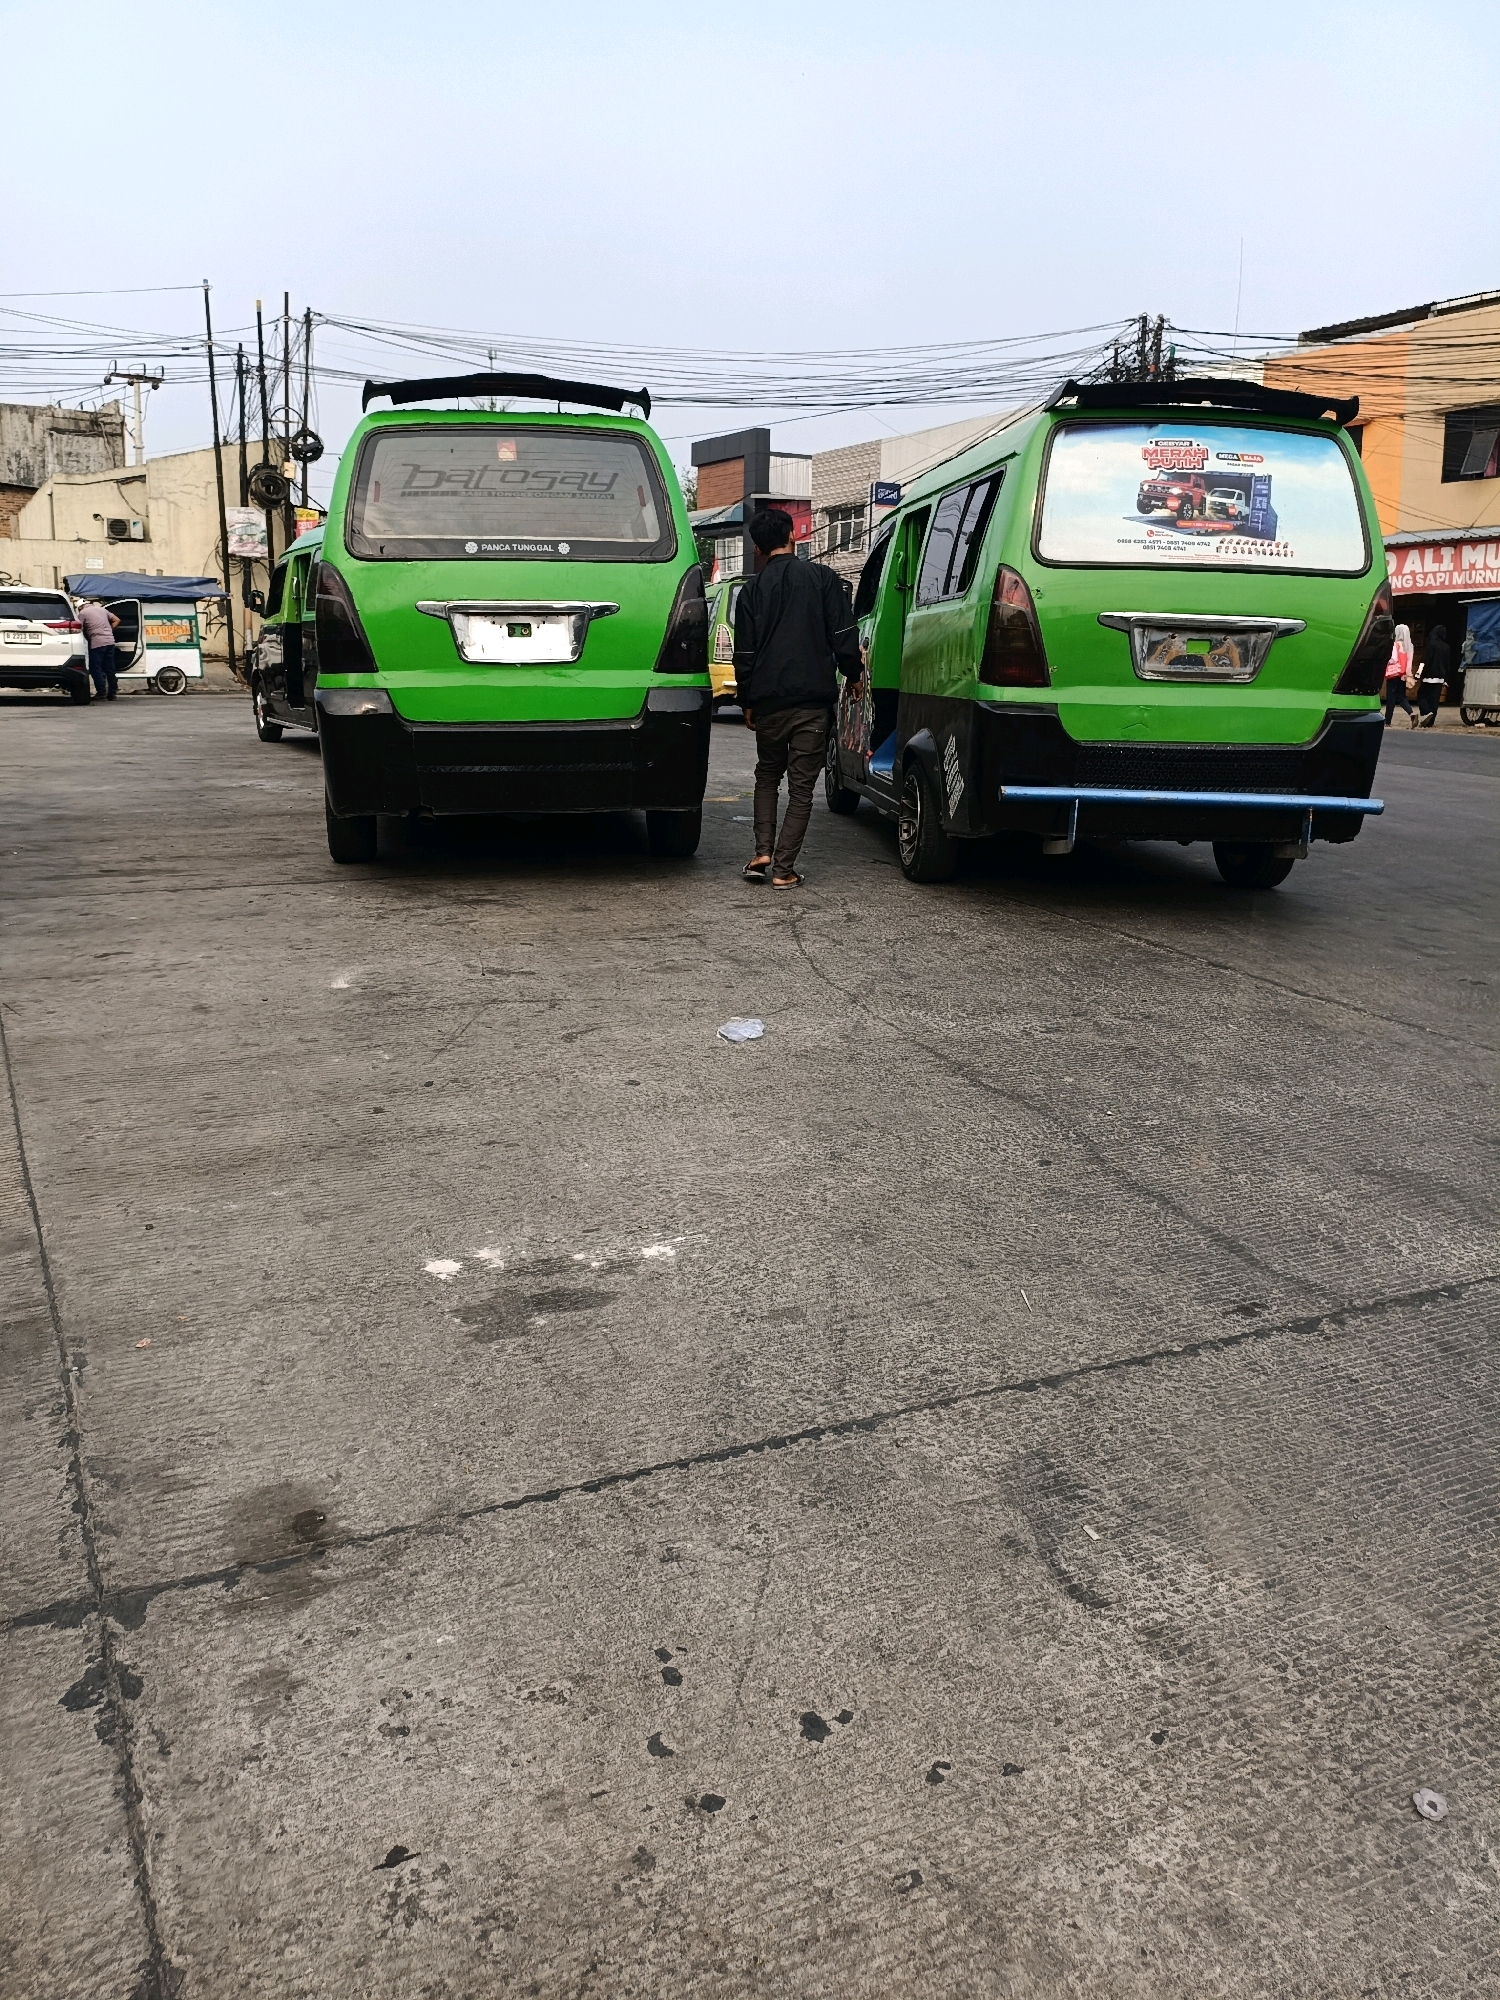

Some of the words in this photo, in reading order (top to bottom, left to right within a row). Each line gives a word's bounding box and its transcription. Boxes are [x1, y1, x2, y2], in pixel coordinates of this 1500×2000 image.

[1143, 448, 1207, 459] MERAH
[1148, 457, 1203, 468] PUTIH
[481, 543, 511, 552] PANCA
[512, 543, 555, 553] TUNGGAL
[1402, 546, 1455, 575] ALI
[1415, 572, 1450, 588] SAPI
